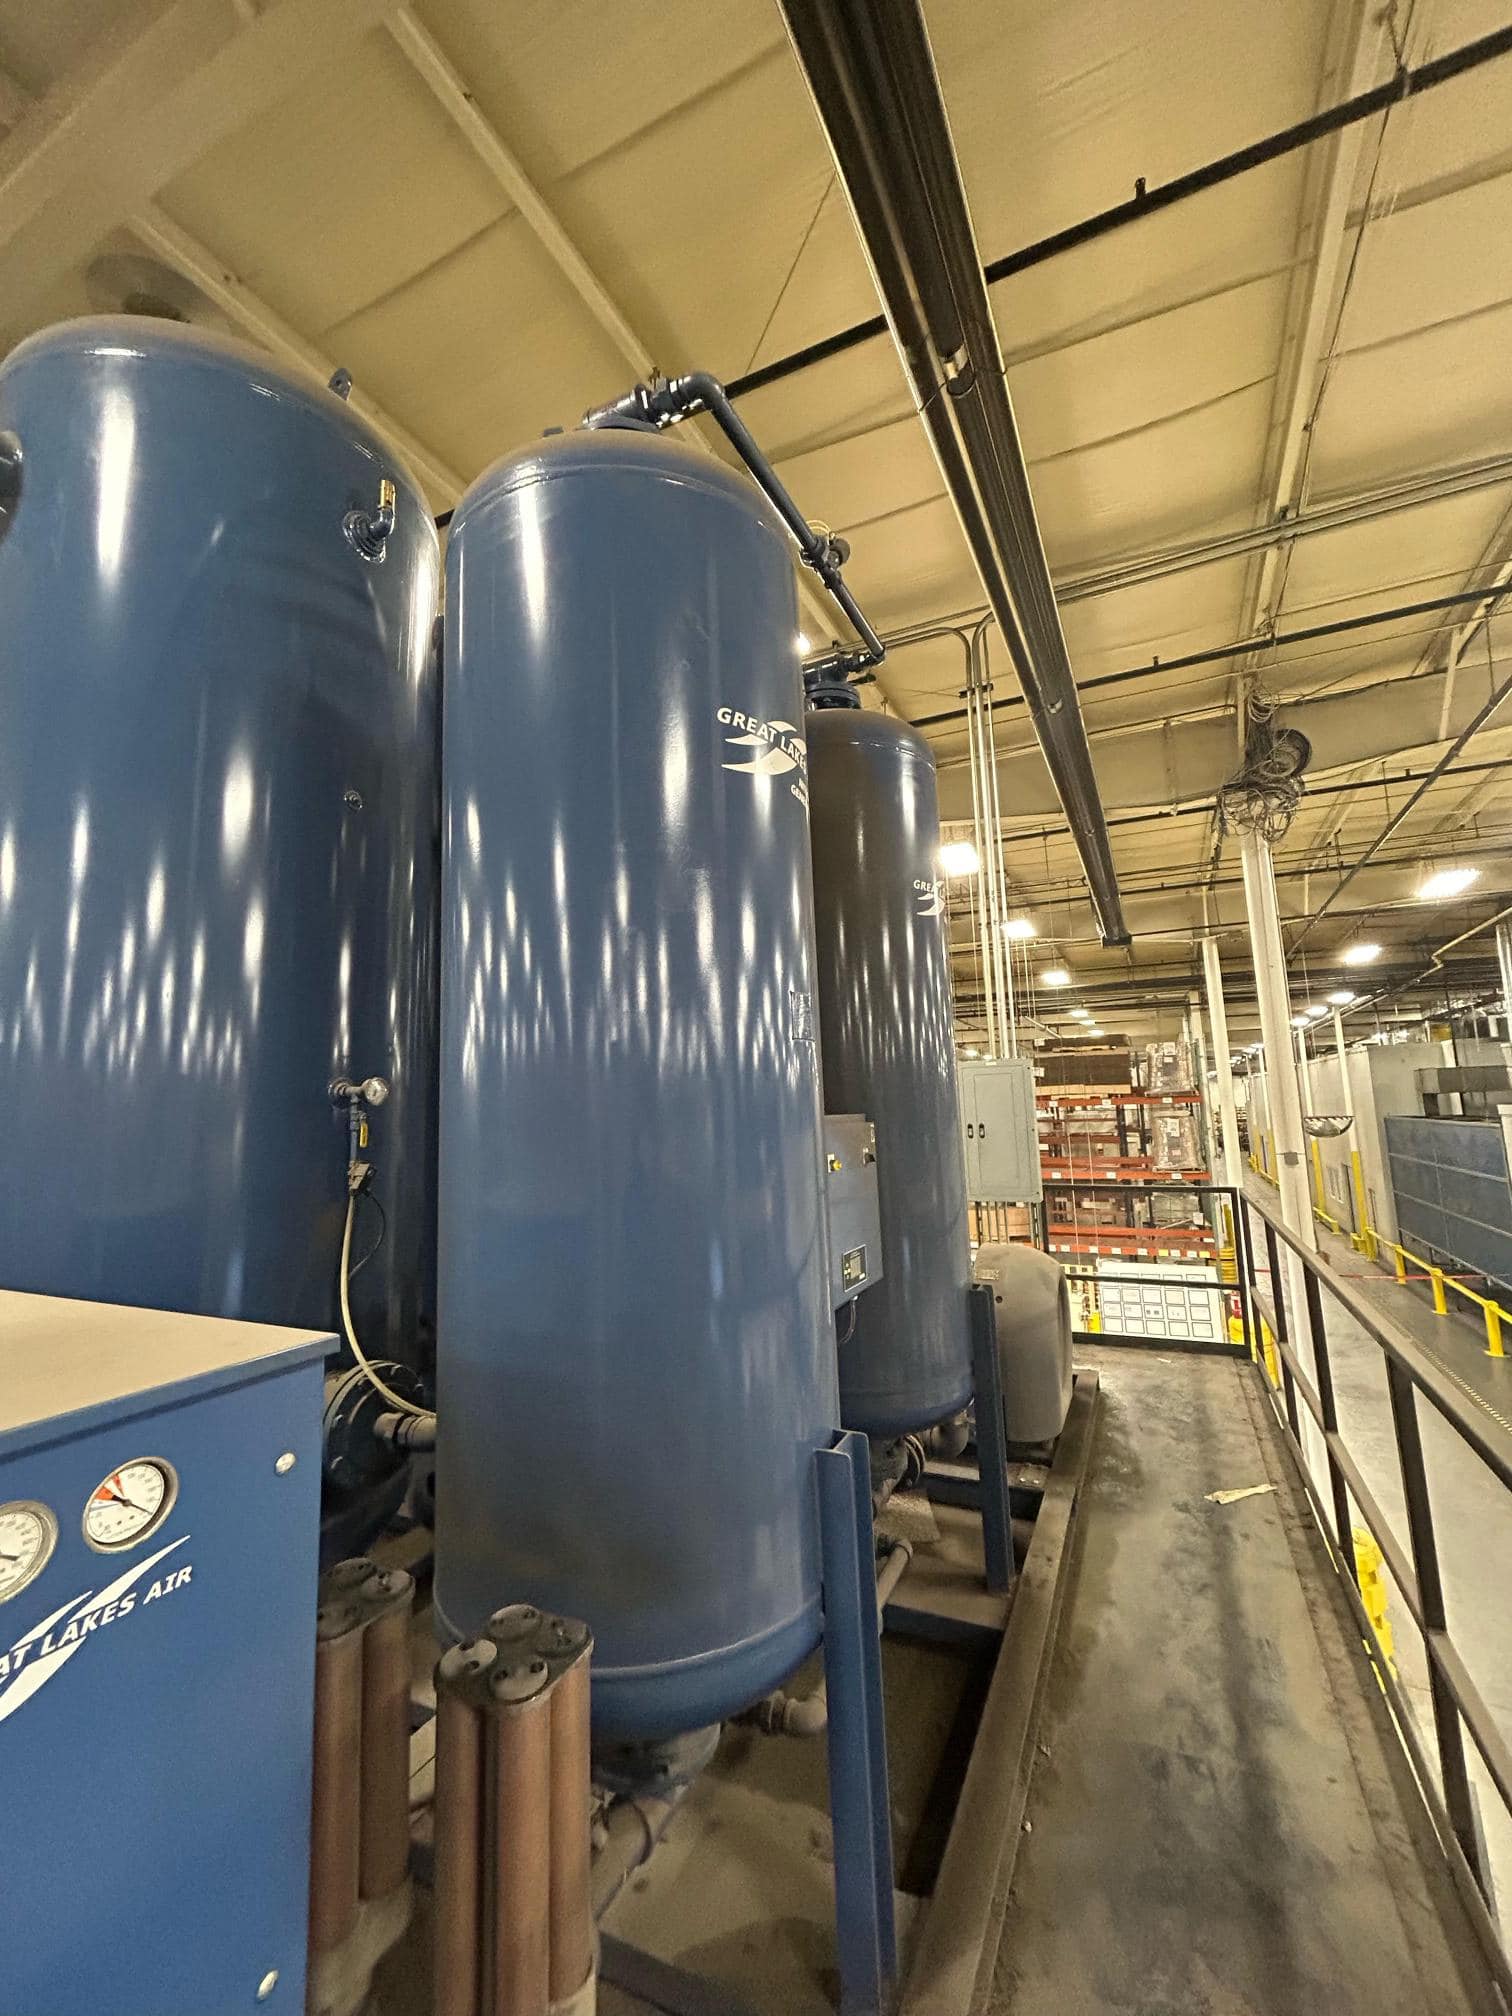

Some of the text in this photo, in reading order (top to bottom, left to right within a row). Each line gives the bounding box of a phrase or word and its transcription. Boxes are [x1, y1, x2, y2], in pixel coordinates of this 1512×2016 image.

[717, 707, 777, 743] GREAT
[40, 1592, 137, 1656] LAKES
[143, 1566, 193, 1605] AIR
